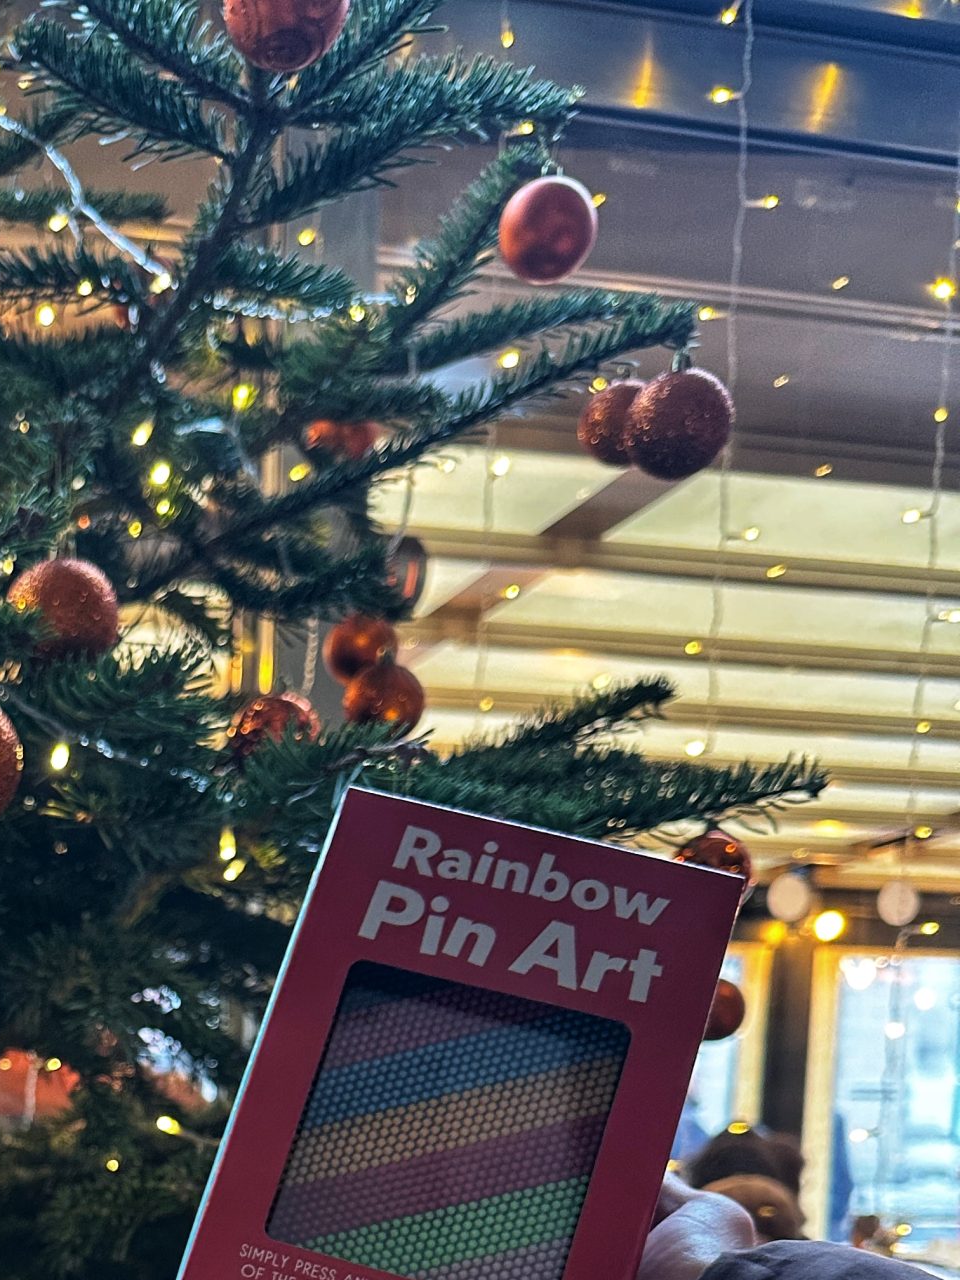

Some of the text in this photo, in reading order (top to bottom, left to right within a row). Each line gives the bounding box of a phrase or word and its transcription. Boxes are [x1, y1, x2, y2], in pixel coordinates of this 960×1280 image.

[392, 825, 671, 925] Rainbow
[357, 880, 664, 1003] Pin Art
[239, 1243, 289, 1268] SIMPLY
[241, 1264, 265, 1280] OF
